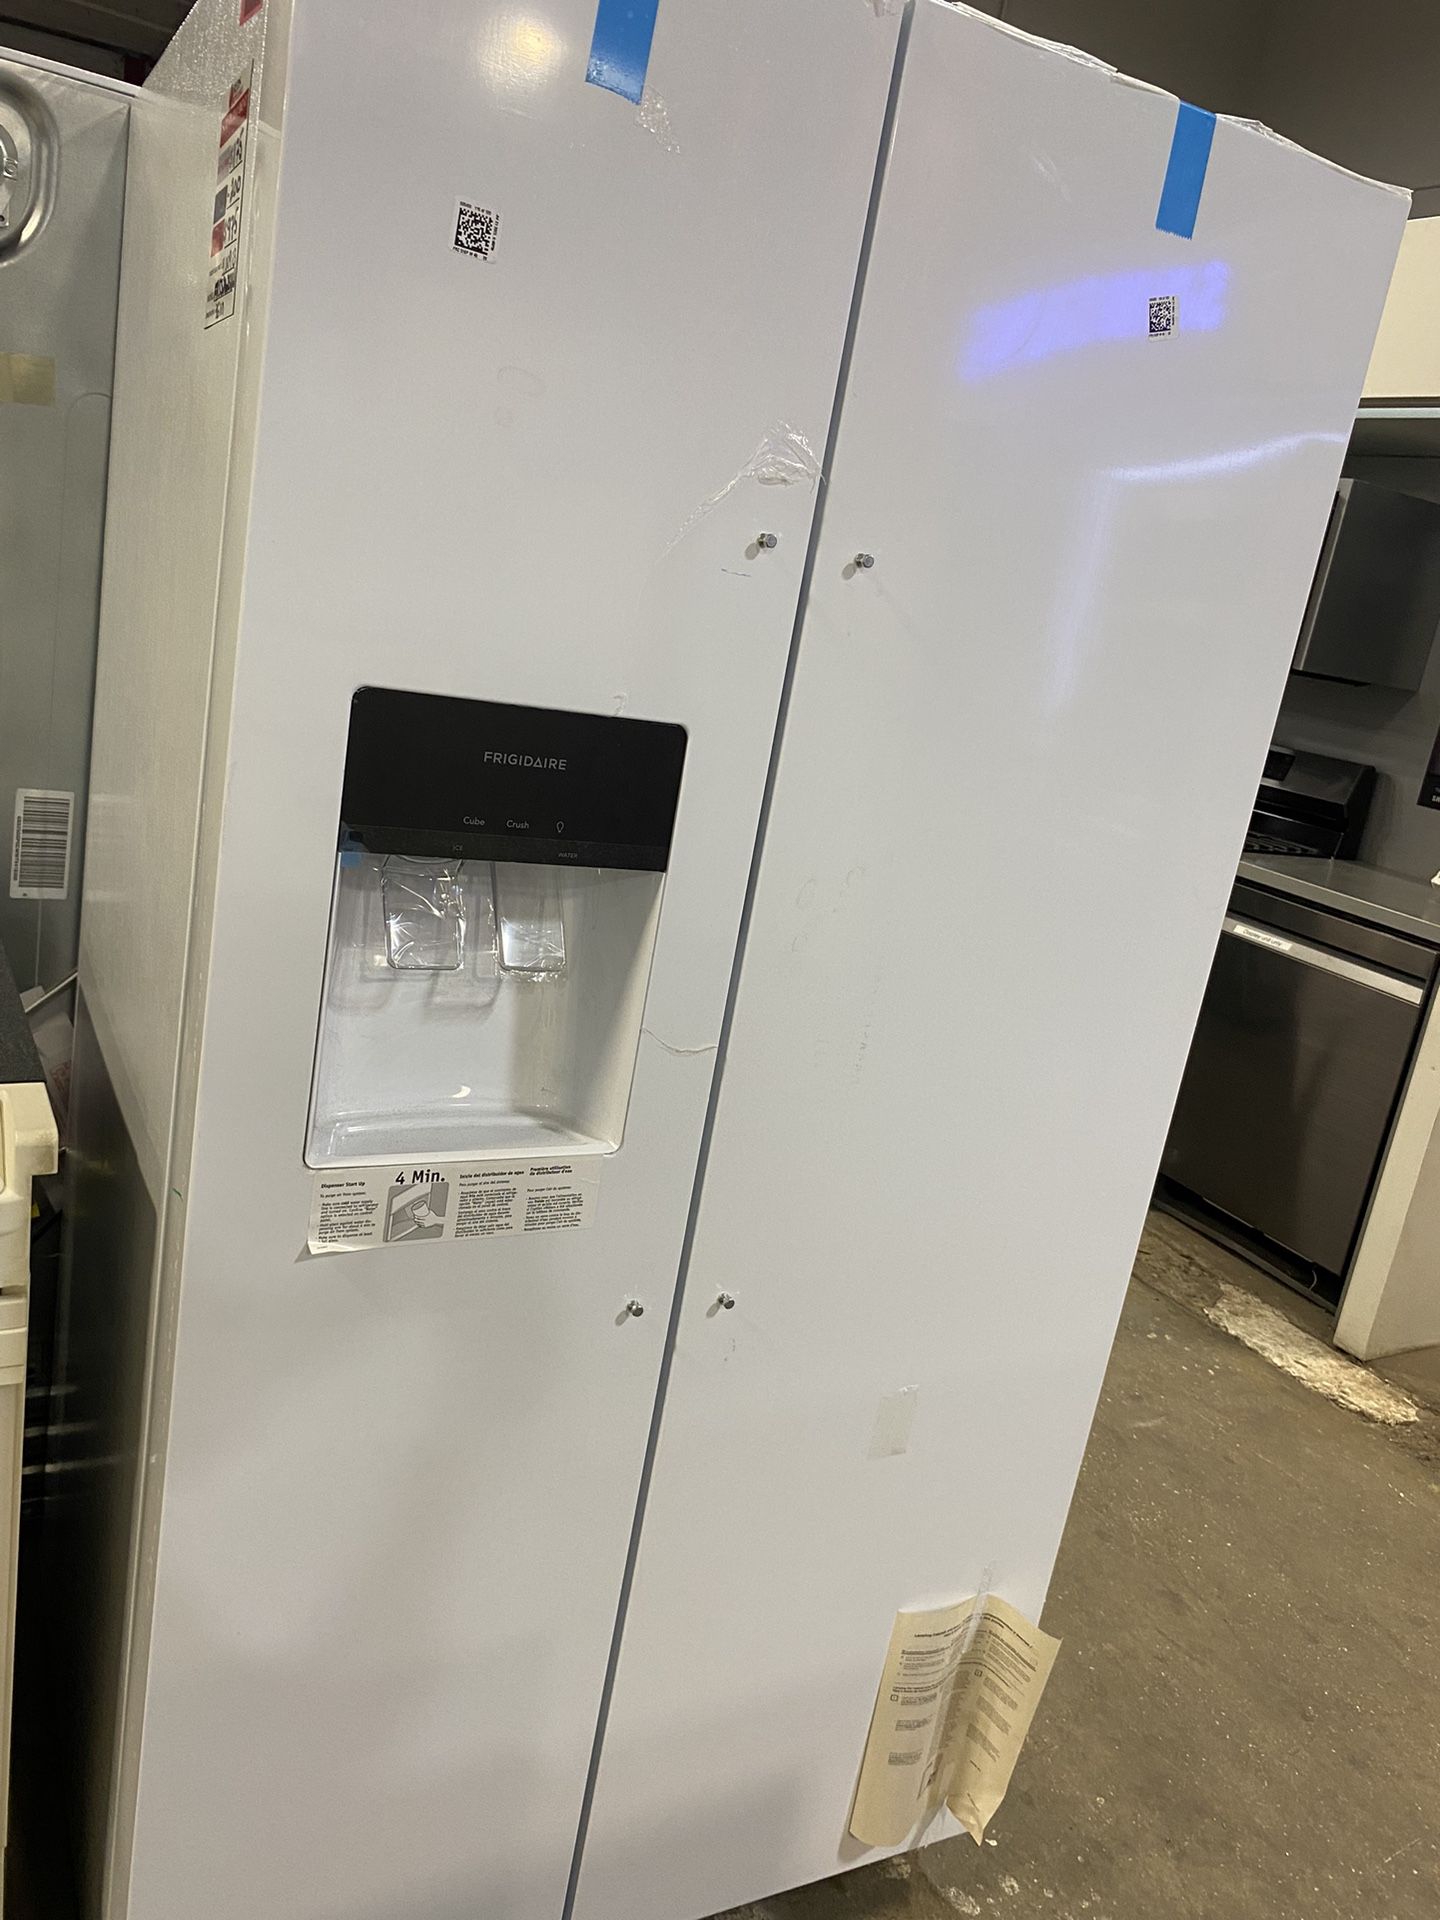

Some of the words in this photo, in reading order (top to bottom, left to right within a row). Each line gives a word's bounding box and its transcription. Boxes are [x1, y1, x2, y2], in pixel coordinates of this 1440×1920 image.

[483, 751, 568, 771] FRIGIDAIRE
[463, 816, 486, 826] Cube
[506, 820, 530, 829] Crush
[395, 1171, 405, 1185] 4
[411, 1169, 446, 1184] Min.
